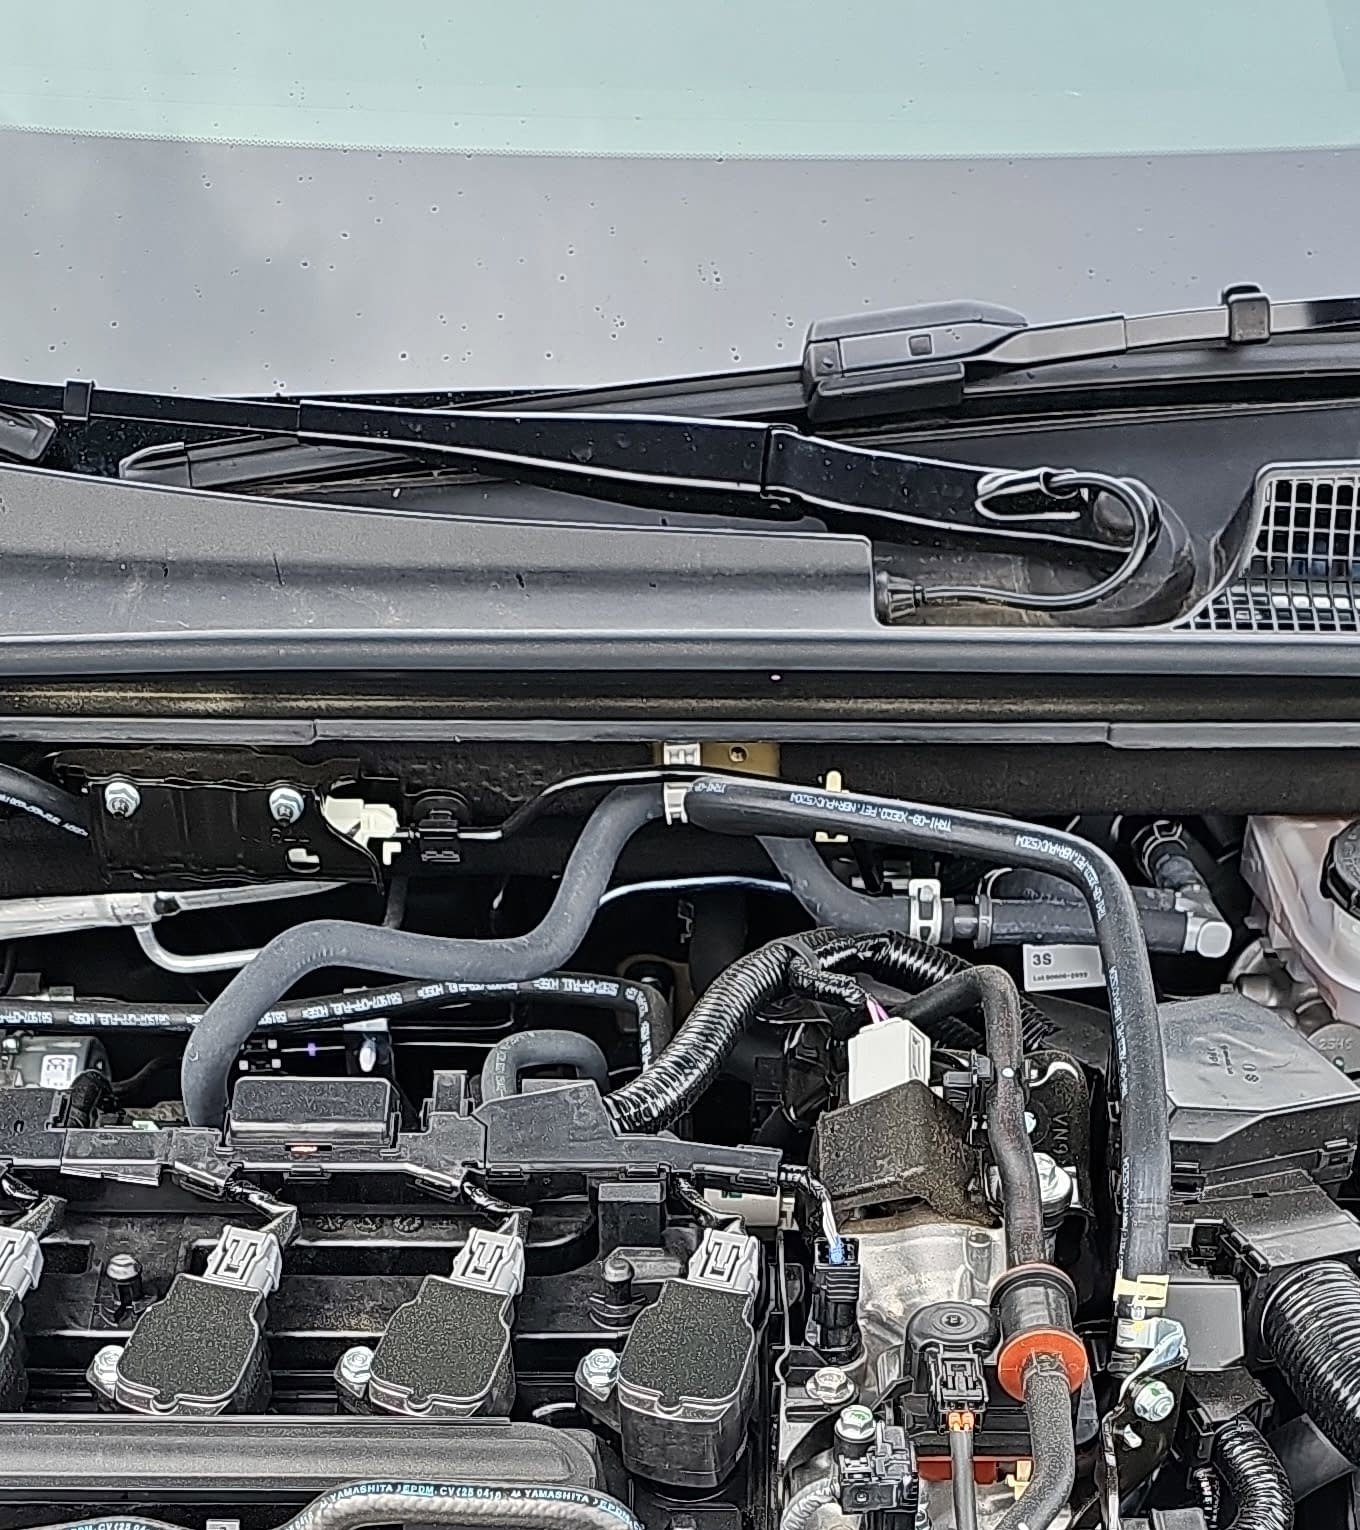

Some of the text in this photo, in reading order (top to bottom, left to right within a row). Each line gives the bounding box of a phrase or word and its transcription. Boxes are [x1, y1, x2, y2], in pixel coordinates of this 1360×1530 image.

[1032, 953, 1052, 966] 3S
[330, 1483, 394, 1506] YAMASHITA
[524, 1488, 590, 1503] YAMASHITA
